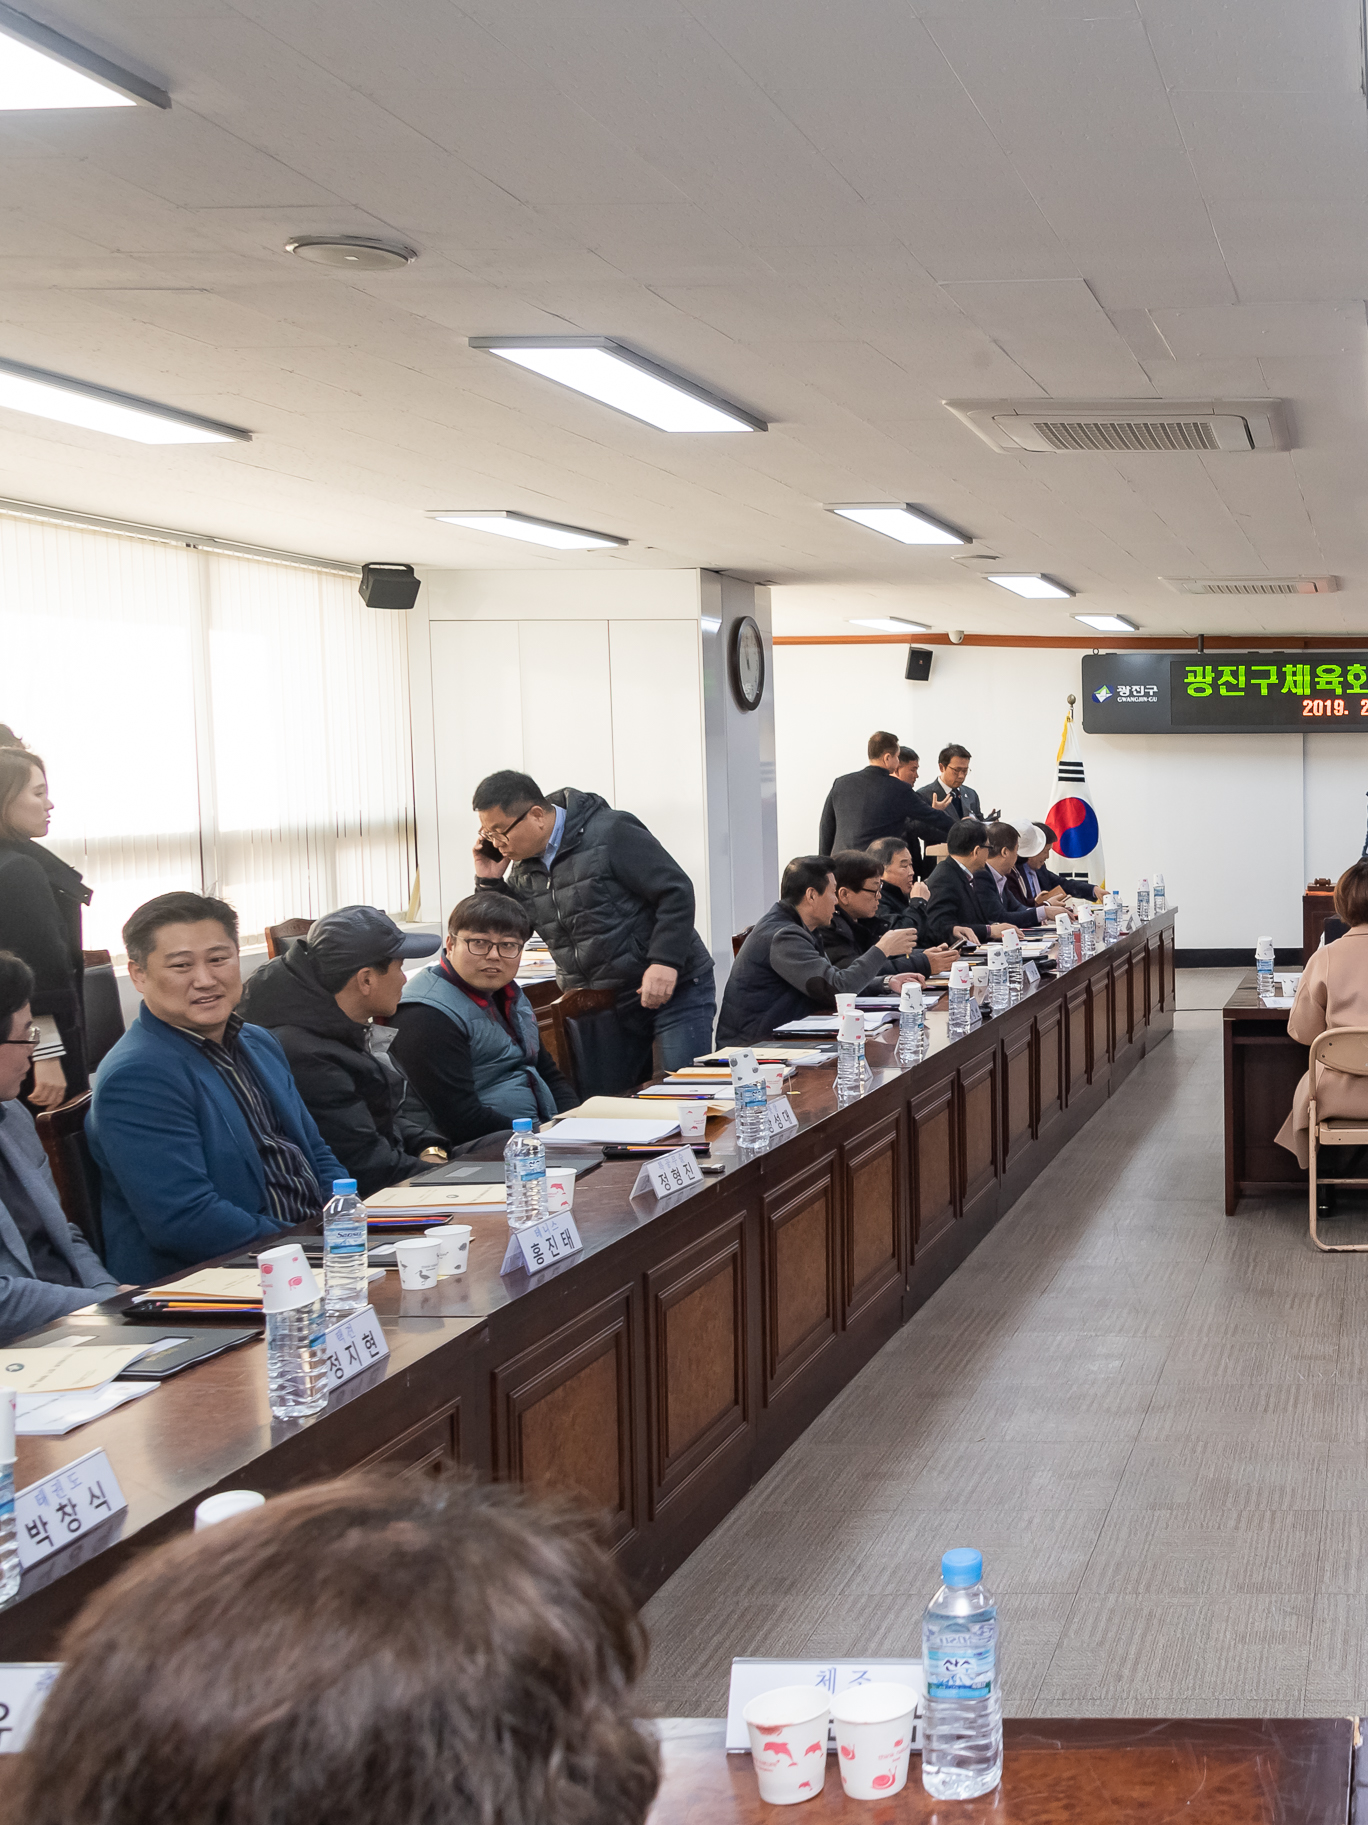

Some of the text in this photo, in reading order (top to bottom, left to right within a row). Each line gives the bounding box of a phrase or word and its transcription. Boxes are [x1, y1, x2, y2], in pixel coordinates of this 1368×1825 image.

[1116, 684, 1159, 697] 광진구
[1302, 699, 1349, 716] 2019.
[658, 1162, 695, 1192] 정형진
[534, 1221, 560, 1239] 테니스
[530, 1228, 576, 1265] 홍진태
[326, 1330, 380, 1380] 정지현
[34, 1471, 83, 1509] 태권도
[25, 1480, 112, 1547] 박창식
[943, 1659, 971, 1673] 산수
[815, 1667, 872, 1695] 체조
